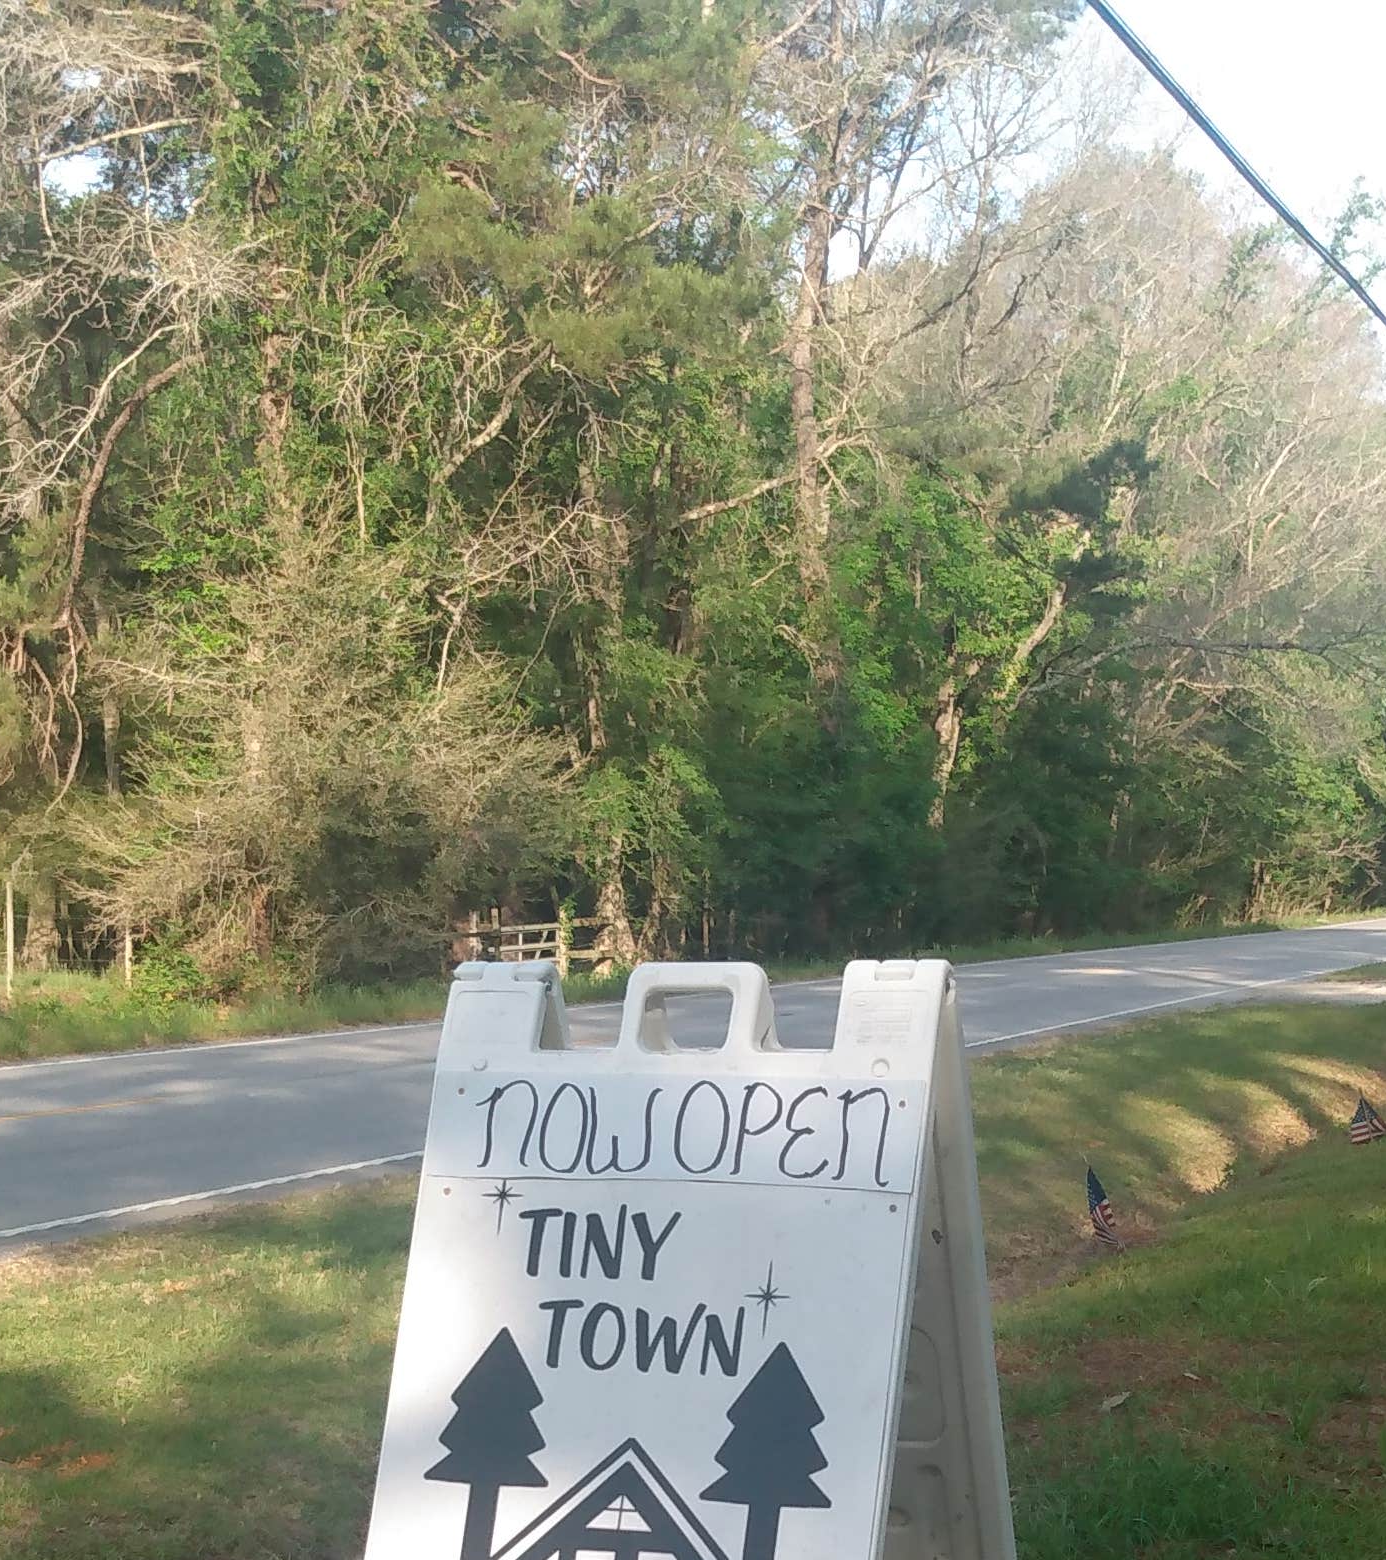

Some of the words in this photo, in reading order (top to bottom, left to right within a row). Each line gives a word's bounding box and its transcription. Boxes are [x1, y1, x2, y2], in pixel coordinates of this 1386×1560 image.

[475, 1079, 664, 1175] NOW
[673, 1080, 891, 1187] OPEN
[518, 1204, 682, 1281] TINY
[538, 1299, 746, 1377] TOWN
